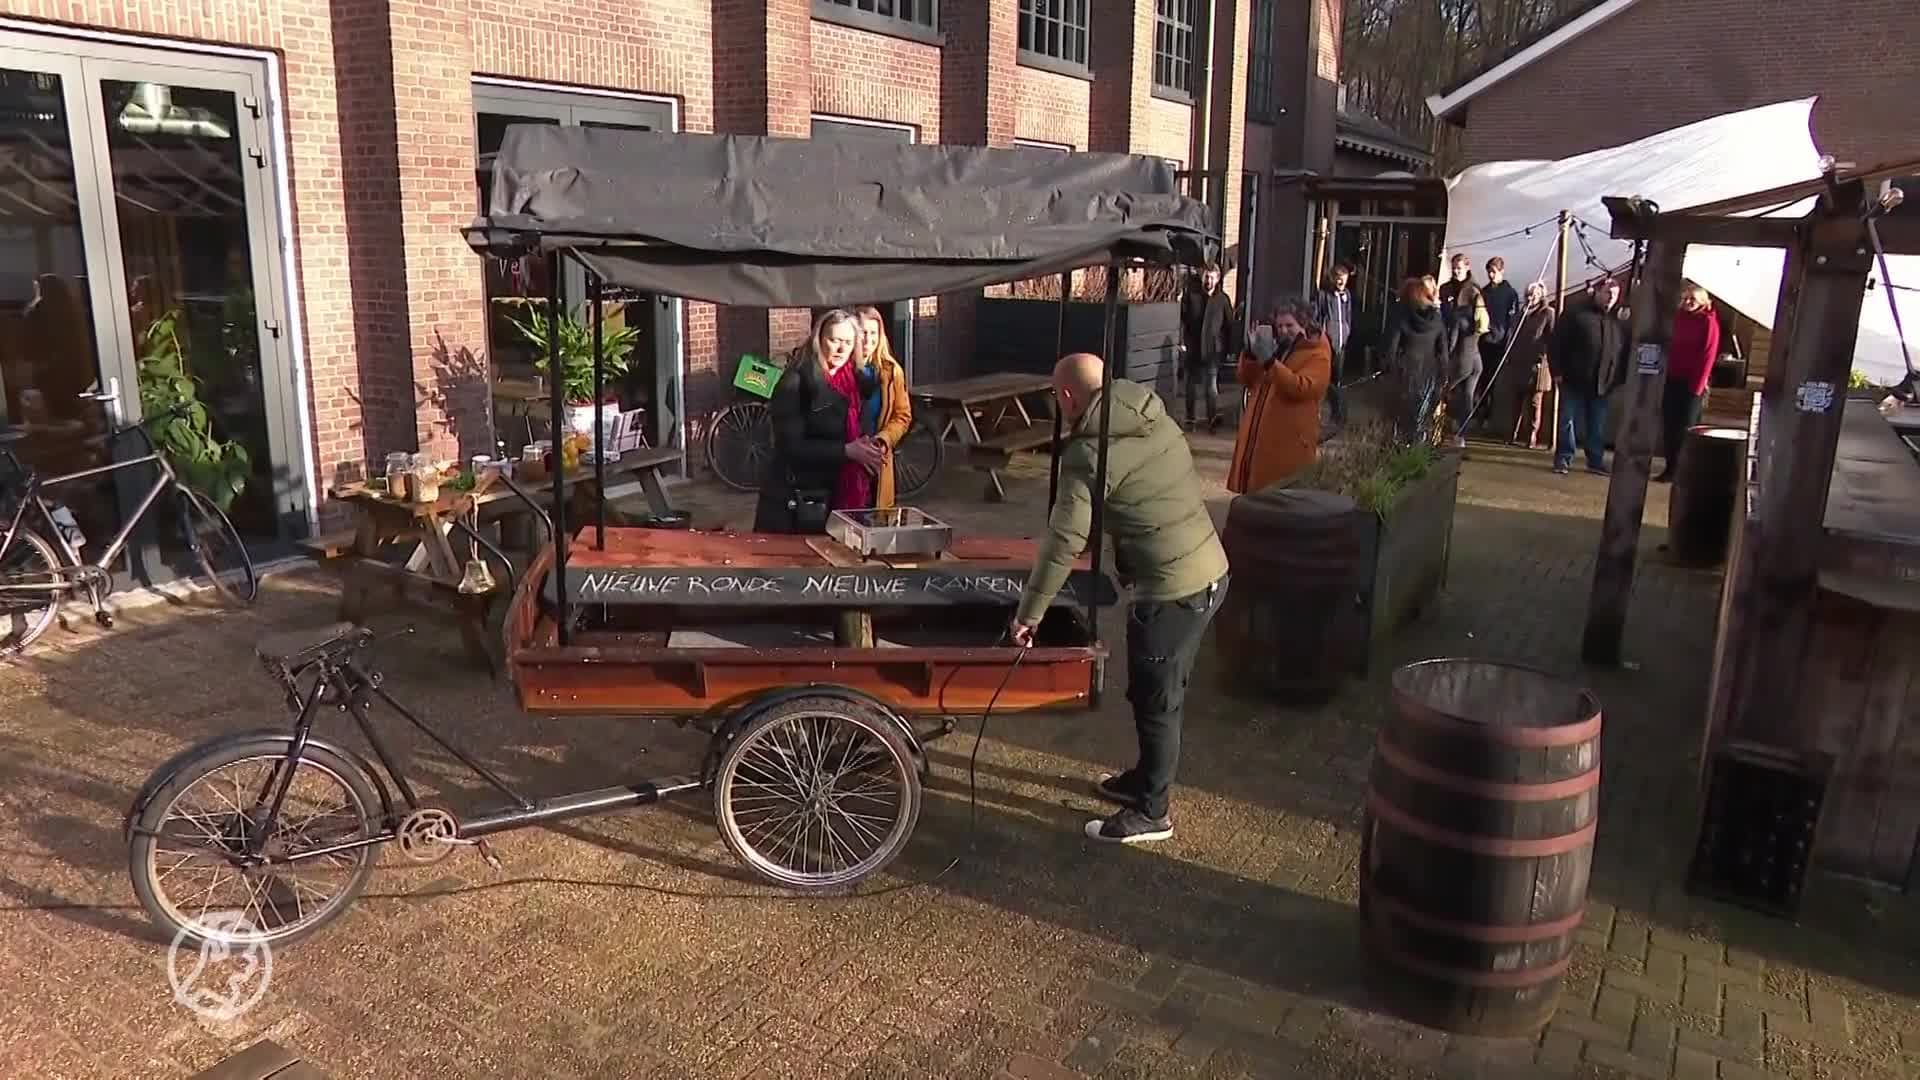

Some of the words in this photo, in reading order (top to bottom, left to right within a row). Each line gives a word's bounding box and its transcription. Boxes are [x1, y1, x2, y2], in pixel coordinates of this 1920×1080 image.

[579, 571, 680, 593] NIEUWE
[687, 576, 784, 593] RONDE
[801, 574, 908, 595] NIEUWE
[922, 576, 1023, 592] KANSEN
